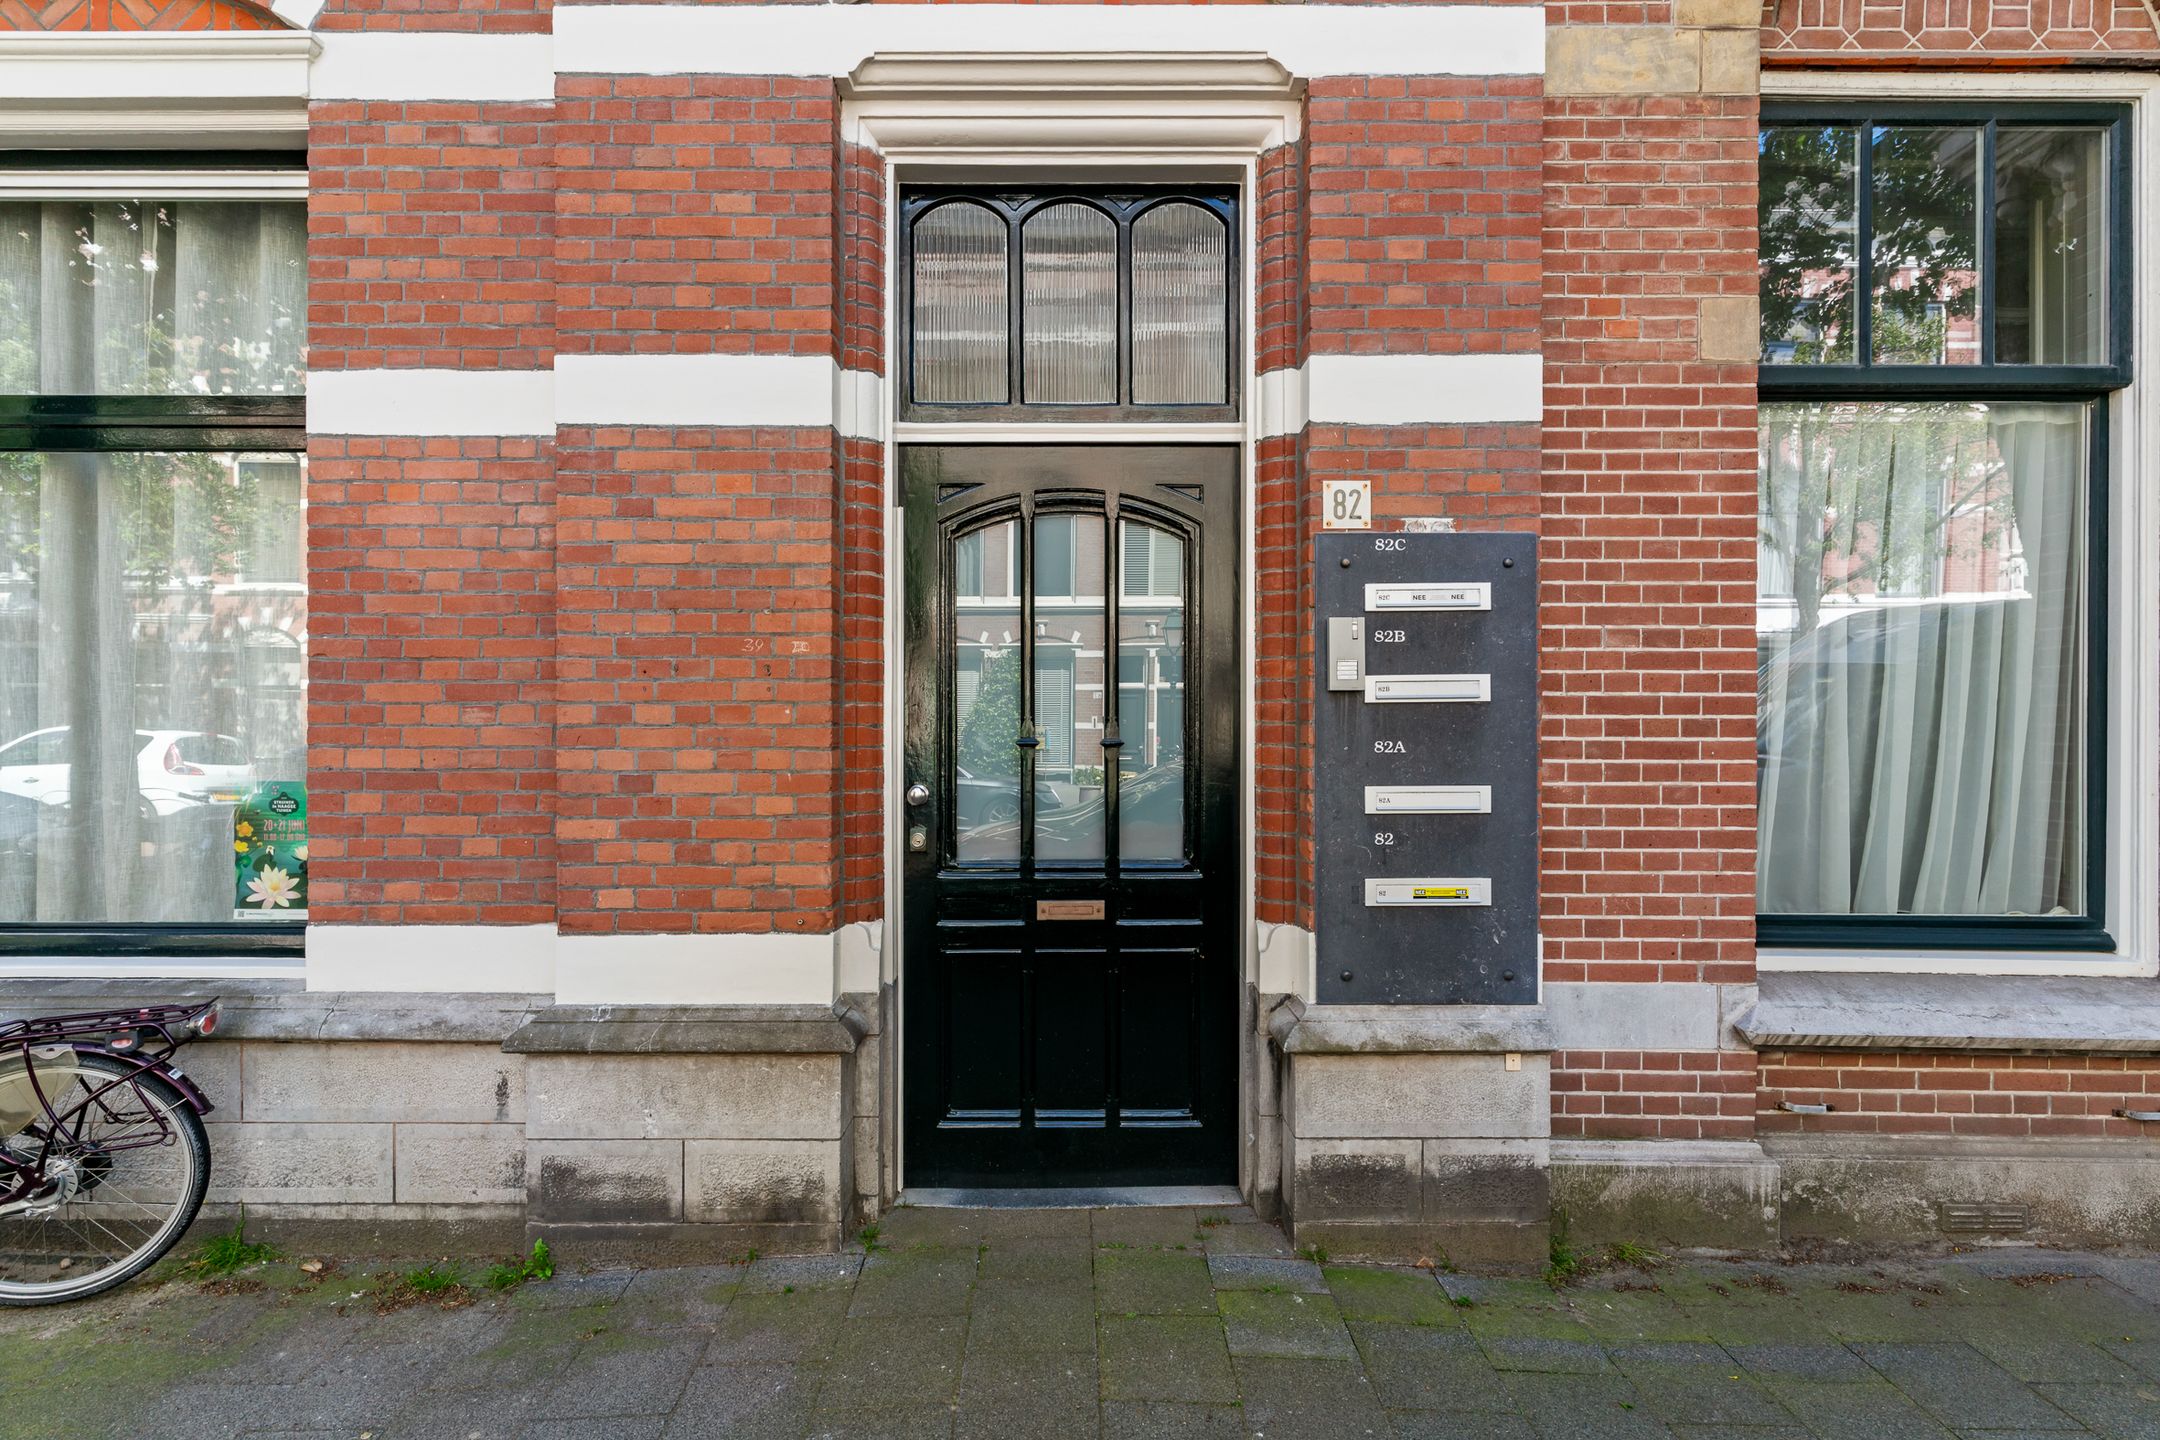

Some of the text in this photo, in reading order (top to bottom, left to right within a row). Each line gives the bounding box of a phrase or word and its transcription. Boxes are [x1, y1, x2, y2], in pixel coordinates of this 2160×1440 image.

[1333, 489, 1362, 520] 82
[1374, 538, 1407, 551] 82C
[1374, 630, 1406, 643] 82B
[741, 638, 764, 652] 39
[1374, 741, 1407, 753] 82A
[1374, 832, 1394, 845] 82
